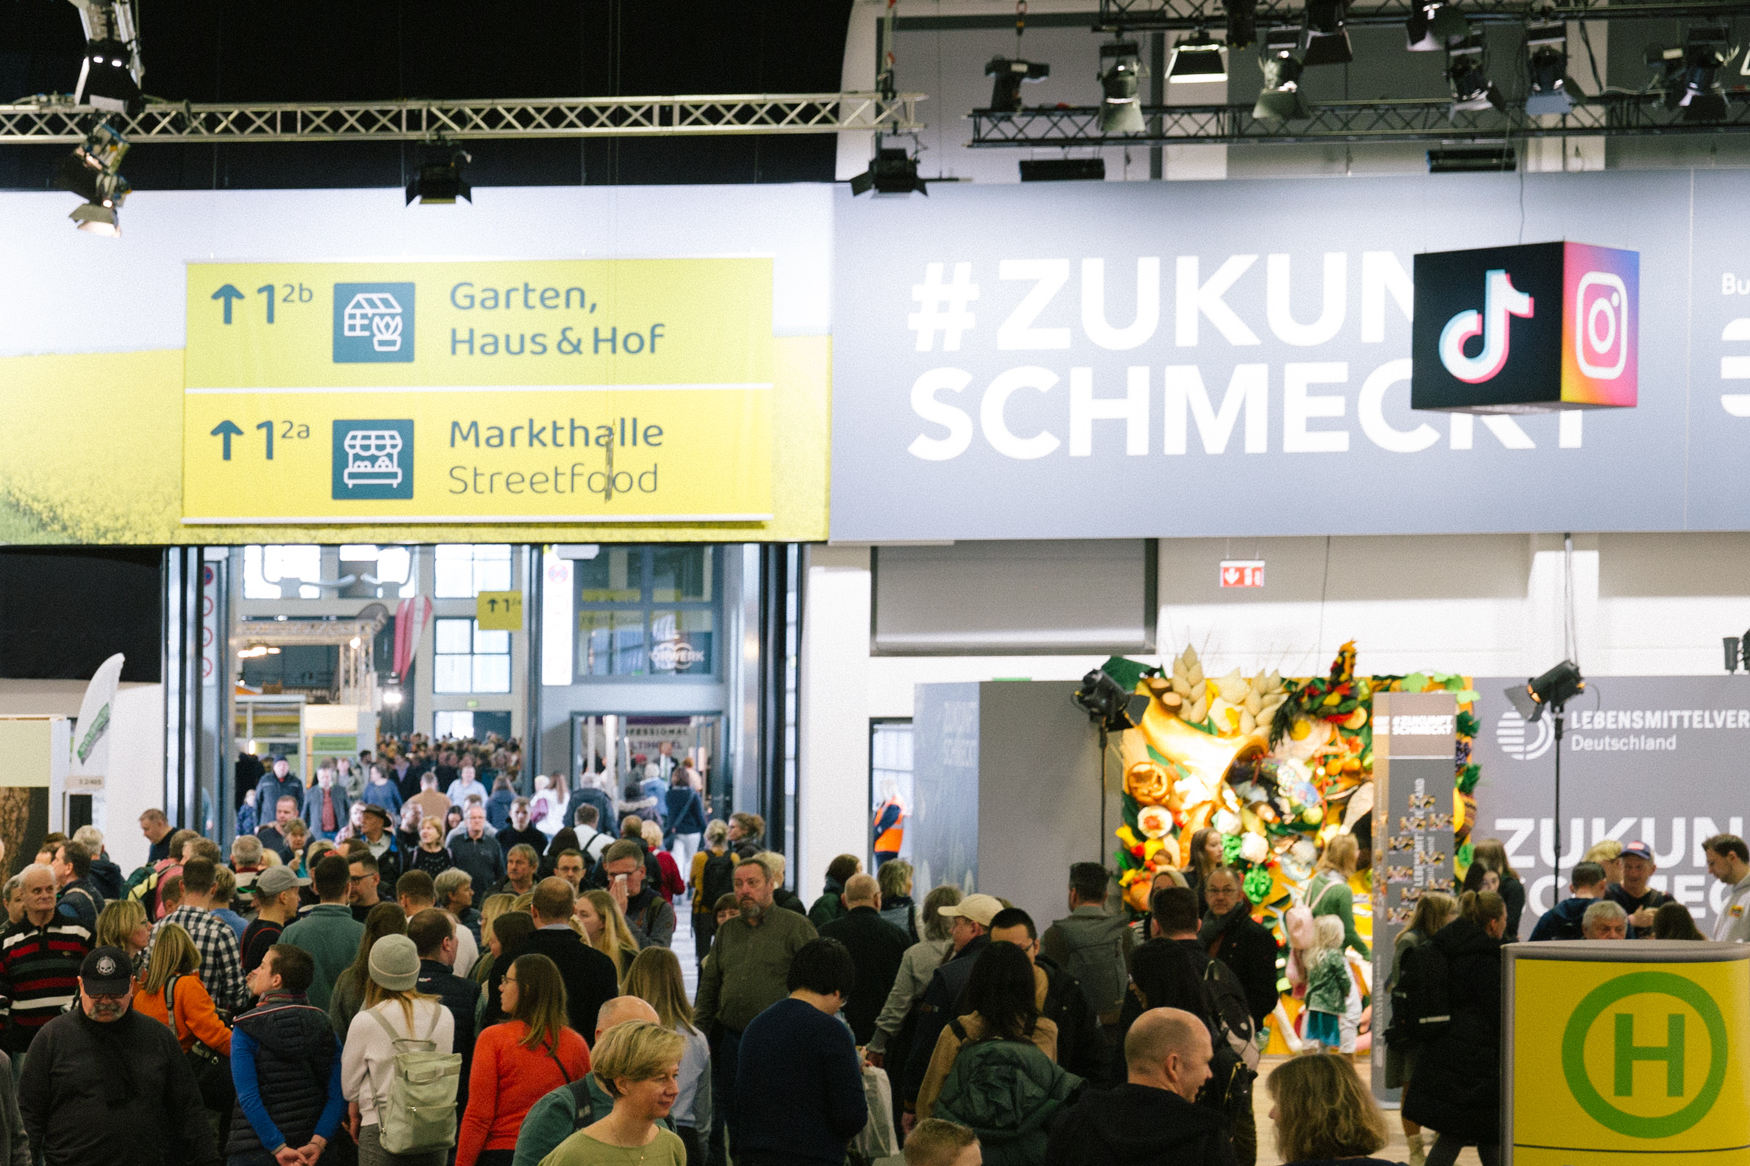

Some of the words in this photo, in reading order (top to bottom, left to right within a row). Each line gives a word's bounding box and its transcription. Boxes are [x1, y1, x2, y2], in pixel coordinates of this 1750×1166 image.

[450, 282, 597, 313] Garten,
[450, 417, 664, 449] Markthalle
[449, 463, 658, 495] Streetfood
[1571, 710, 1750, 730] LEBENSMITTELVER
[1571, 735, 1677, 751] Deutschland
[1614, 1013, 1685, 1097] H
